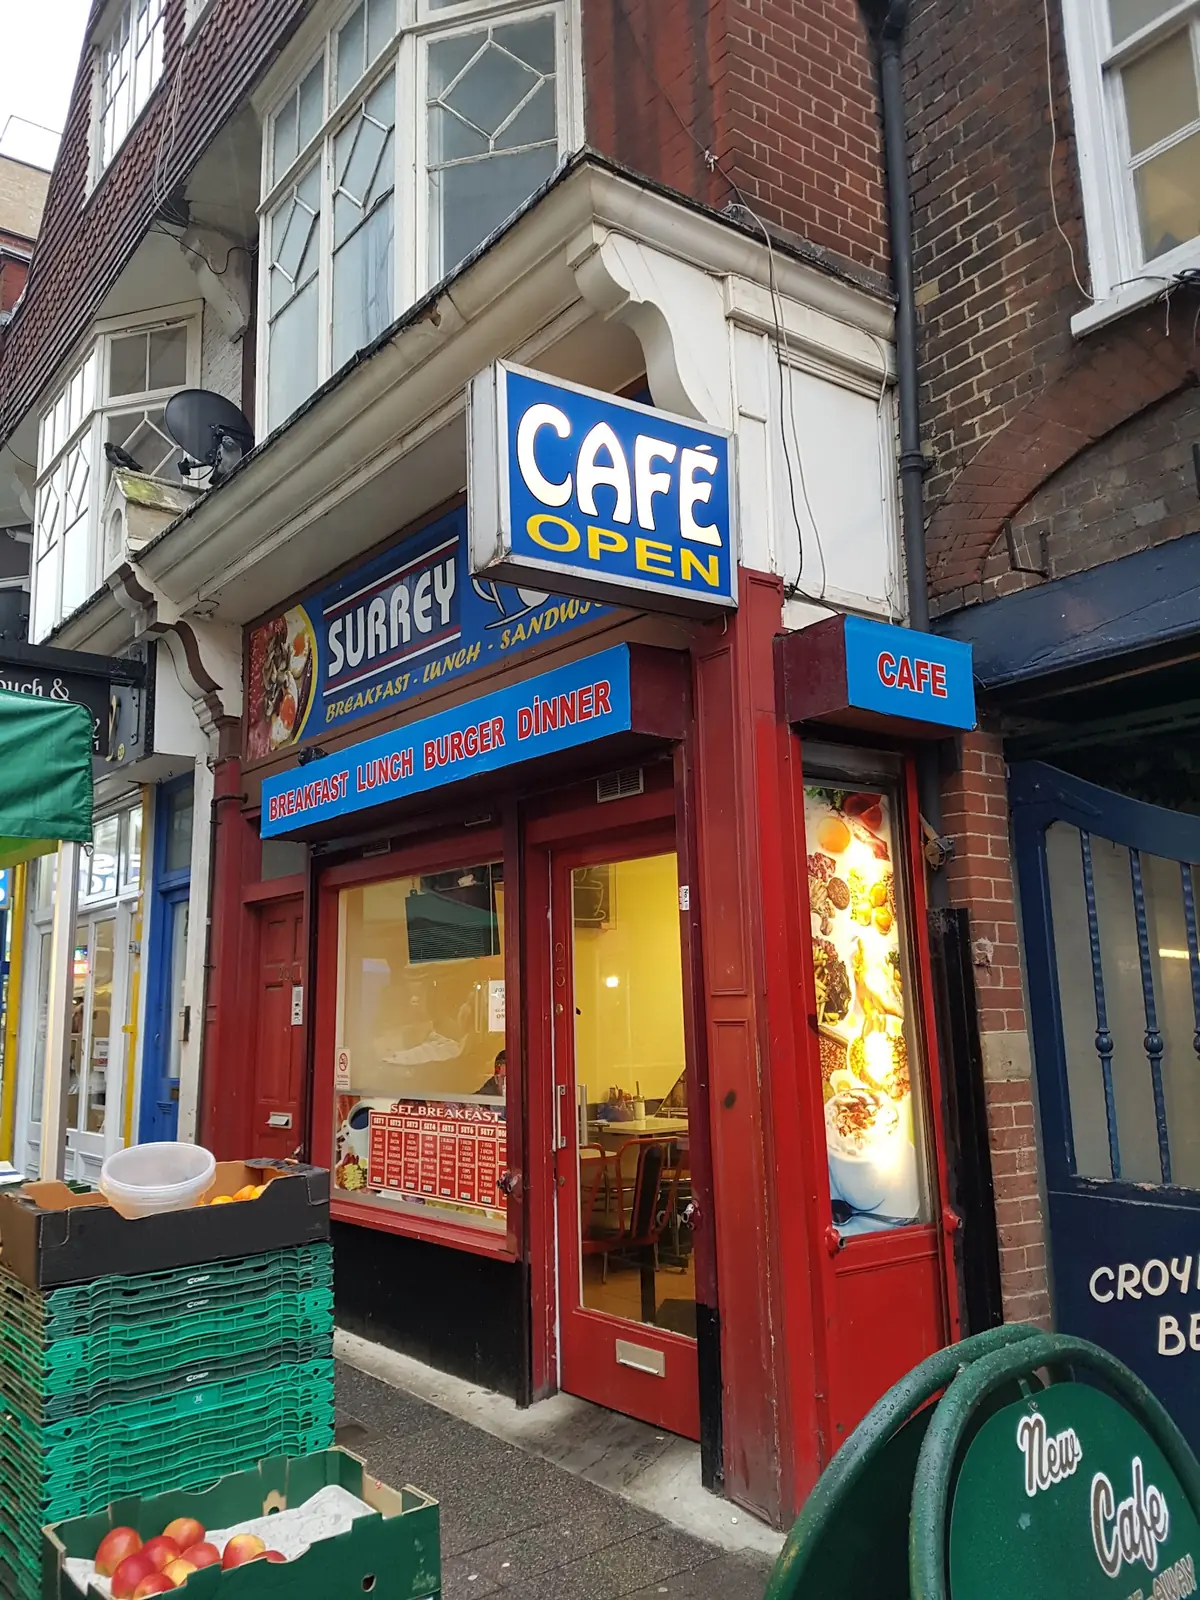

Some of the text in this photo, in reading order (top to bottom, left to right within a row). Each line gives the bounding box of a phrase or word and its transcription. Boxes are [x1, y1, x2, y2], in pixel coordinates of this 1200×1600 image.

[516, 402, 722, 547] CAFÉ
[526, 513, 719, 587] OPEN
[328, 557, 456, 677] SURREY
[325, 673, 410, 724] BREAKFAST
[423, 641, 481, 685] LUNCH
[877, 651, 948, 698] CAFE
[268, 770, 349, 822] BREAKFAST
[356, 746, 414, 793] LUNCH
[423, 715, 506, 772] BURGER
[391, 1105, 502, 1123] SET BREAKFAST
[1089, 1256, 1200, 1303] CROY
[1016, 1413, 1083, 1497] New
[1090, 1456, 1169, 1578] Cafe
